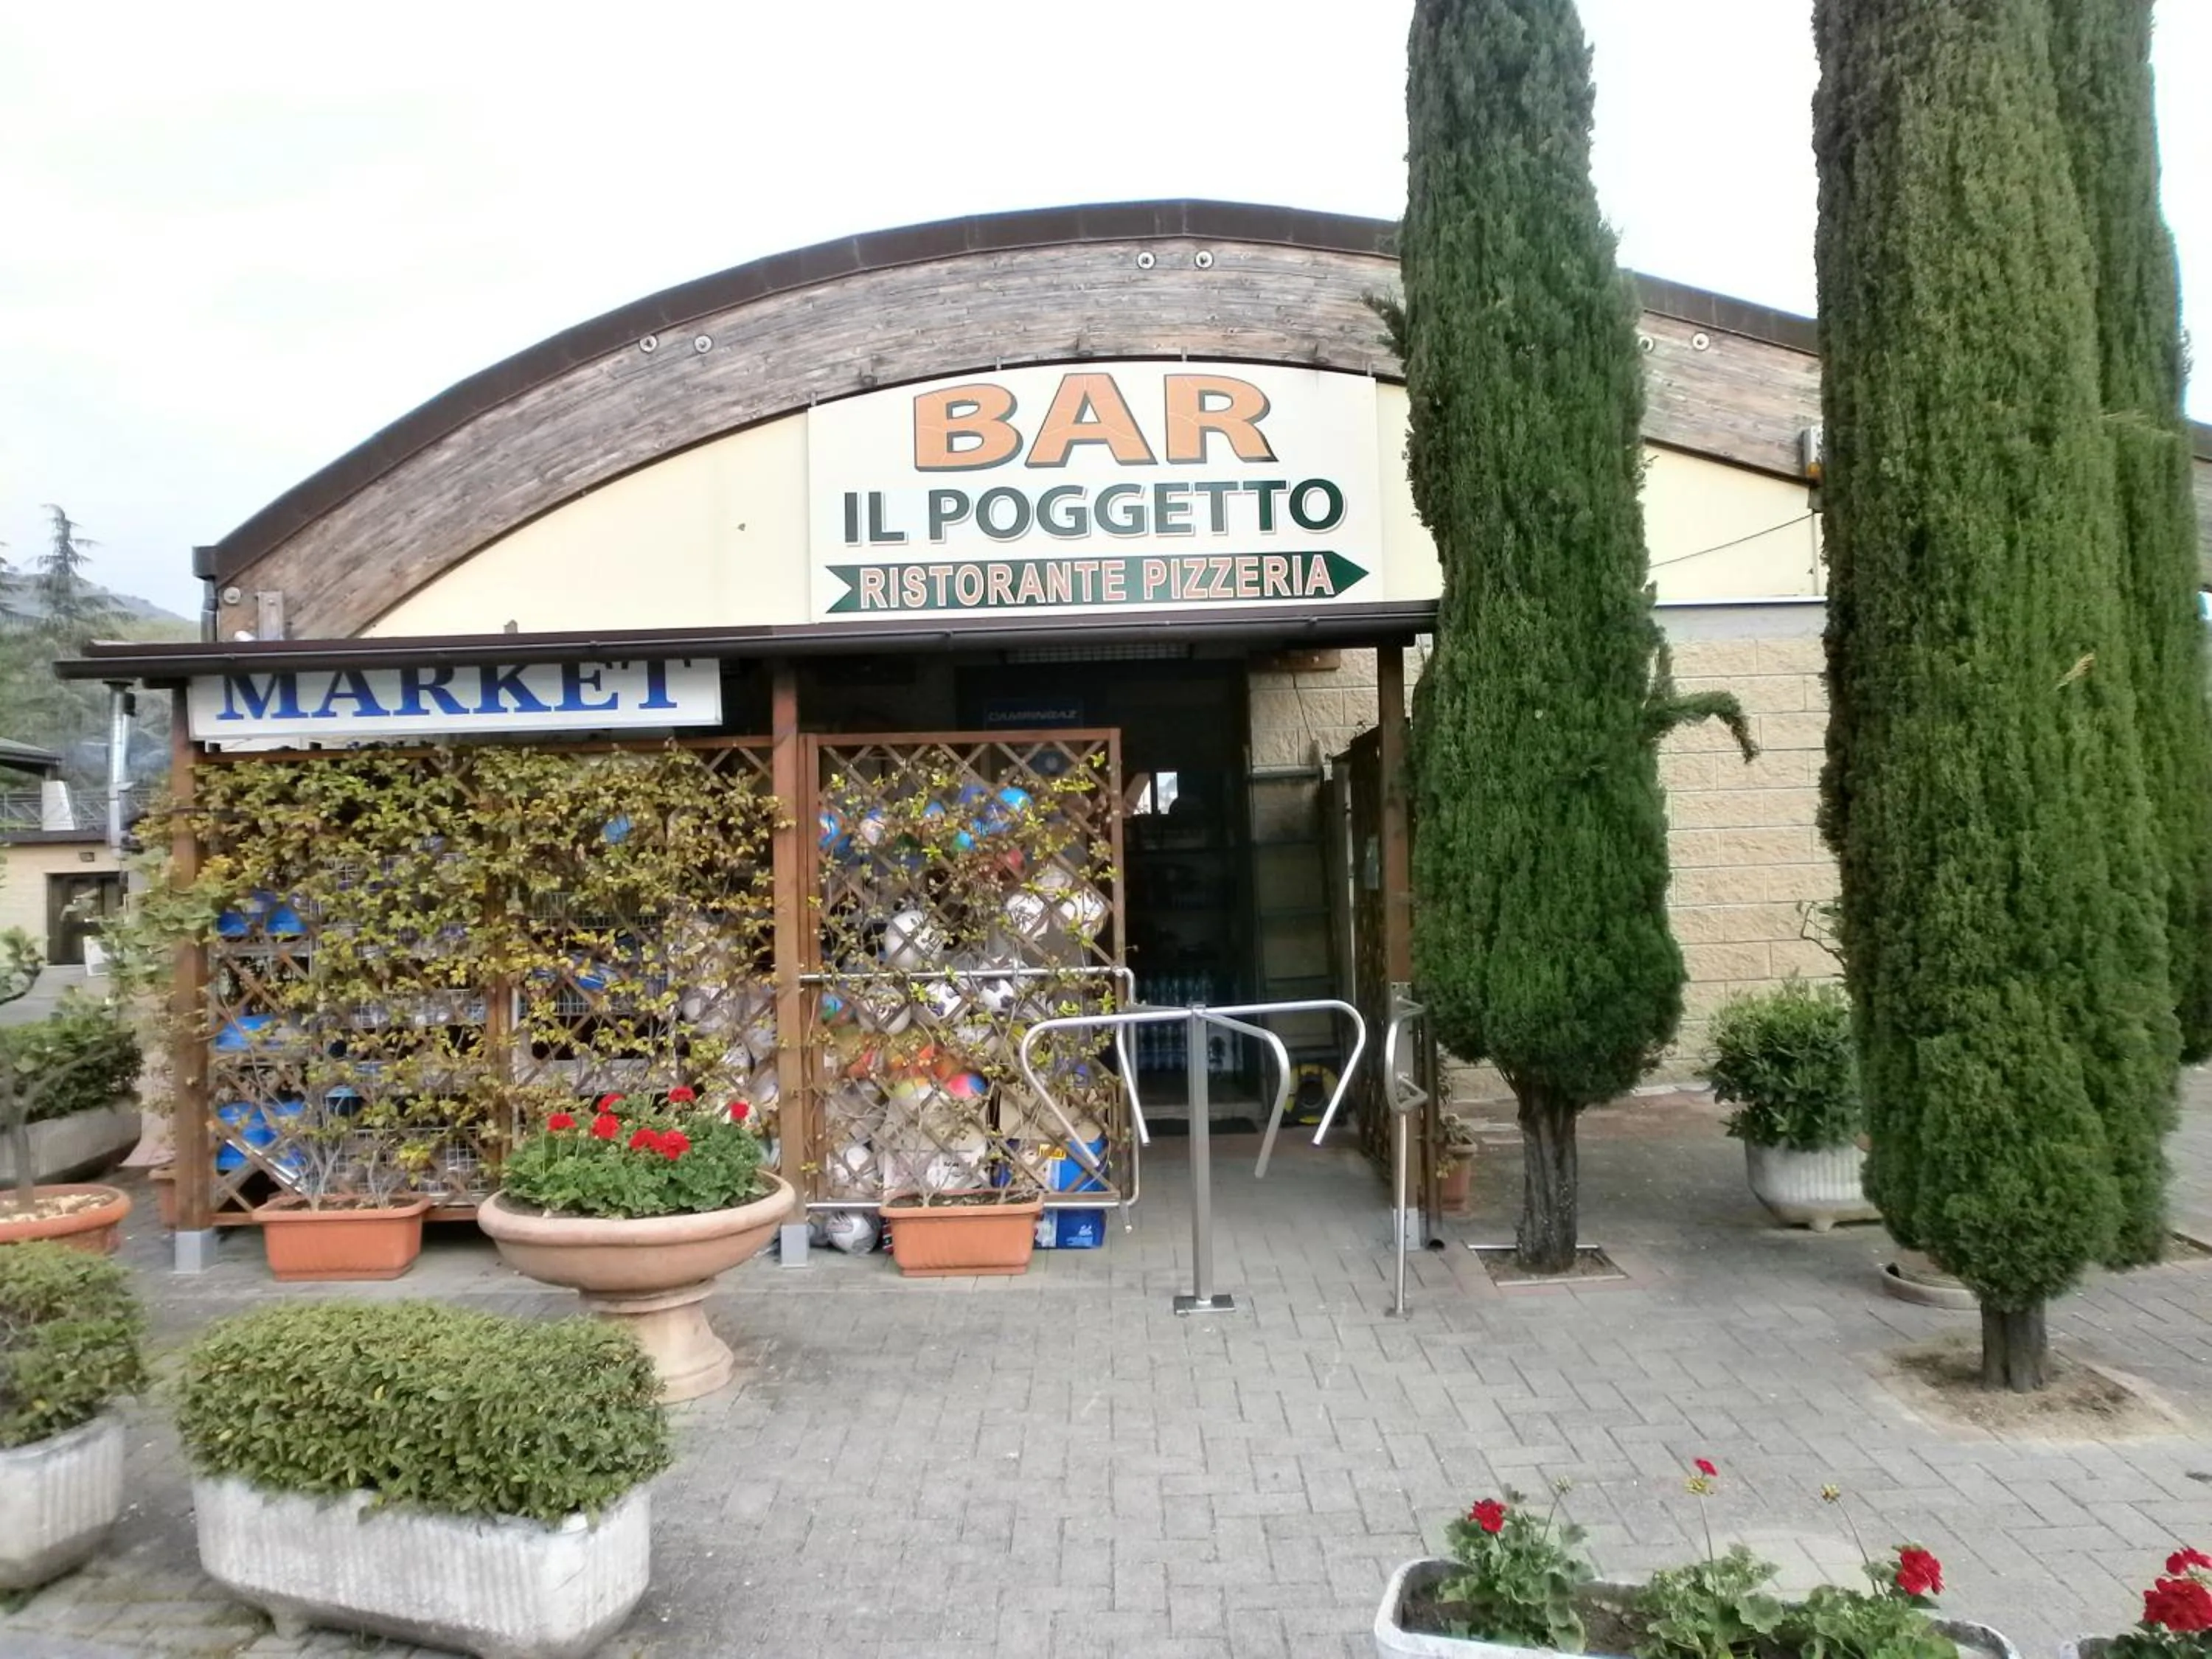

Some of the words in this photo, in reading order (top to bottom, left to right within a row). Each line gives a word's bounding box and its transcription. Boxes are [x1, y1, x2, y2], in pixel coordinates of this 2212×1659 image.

[913, 372, 1279, 472] BAR
[844, 490, 908, 545] IL
[928, 478, 1348, 544] POGGETTO
[859, 559, 1127, 610] RISTORANTE
[1142, 554, 1336, 601] PIZZERIA
[215, 659, 693, 721] MARKET
